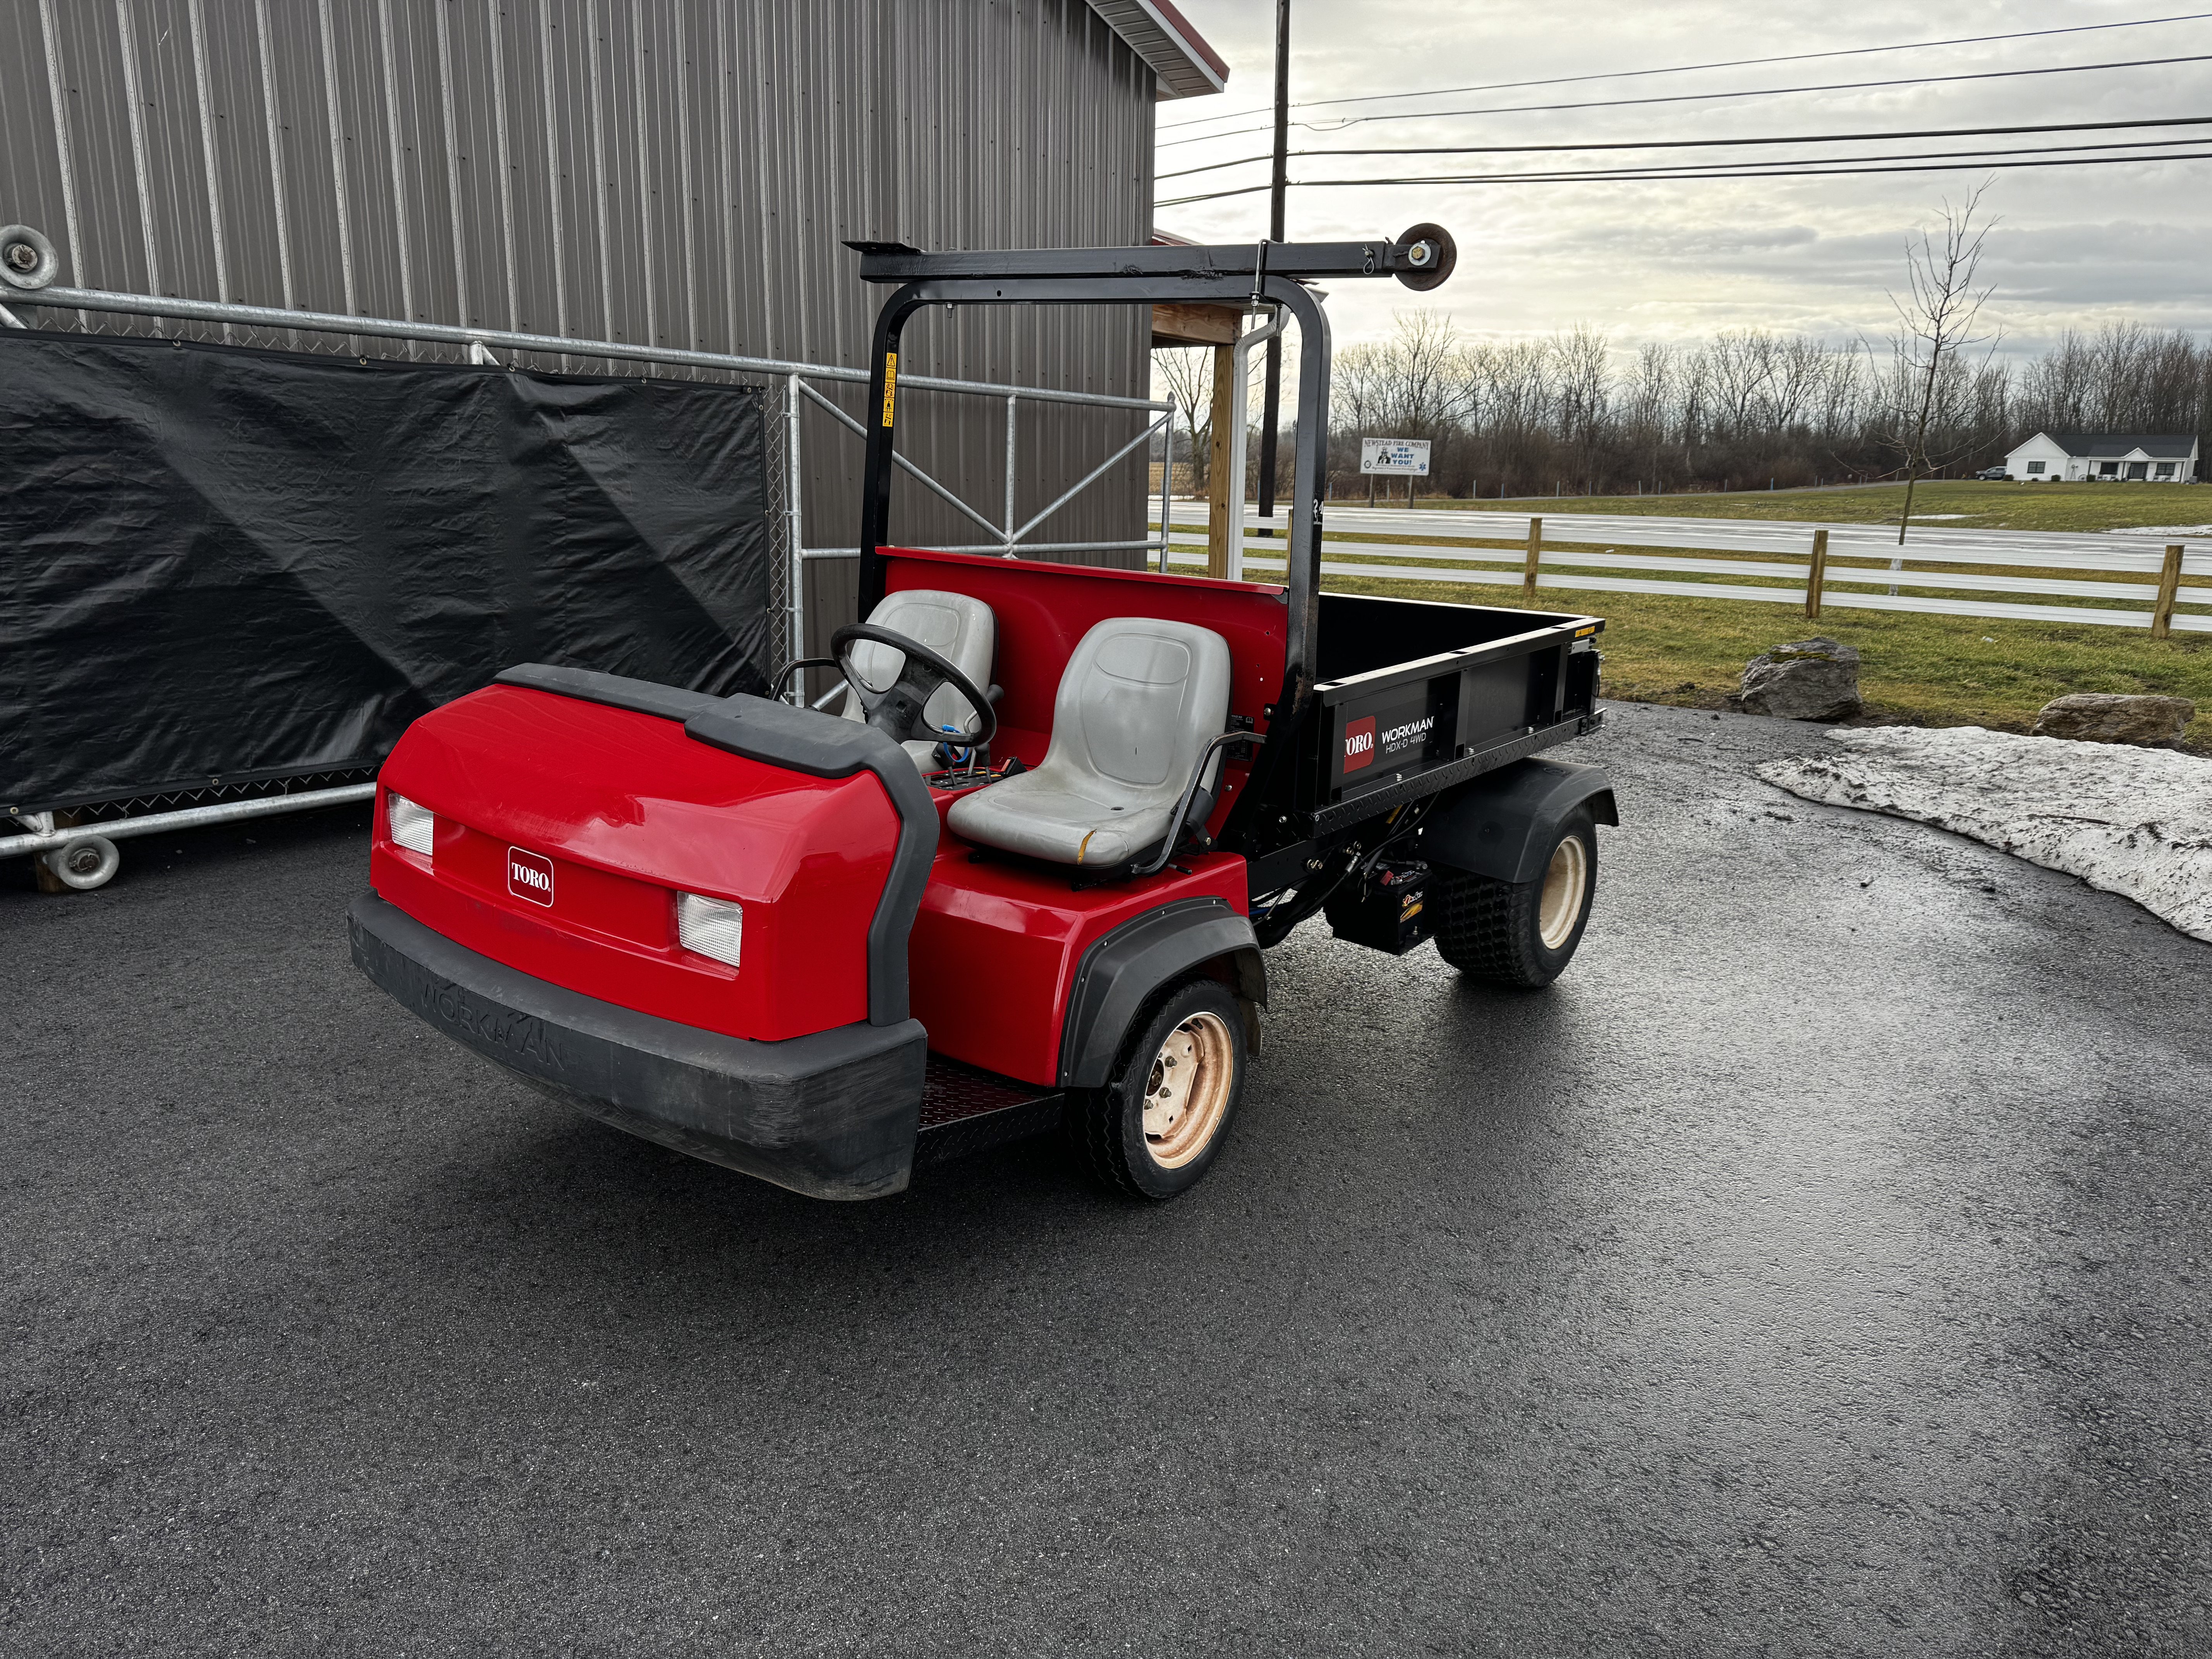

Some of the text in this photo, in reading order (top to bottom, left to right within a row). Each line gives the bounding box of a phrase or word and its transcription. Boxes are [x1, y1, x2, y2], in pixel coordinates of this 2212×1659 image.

[1405, 441, 1429, 450] COMPANY
[1382, 716, 1434, 744] WORKMAN
[1345, 732, 1372, 757] ORO
[1386, 732, 1427, 754] HDX-D 4WD
[512, 862, 550, 890] TORO
